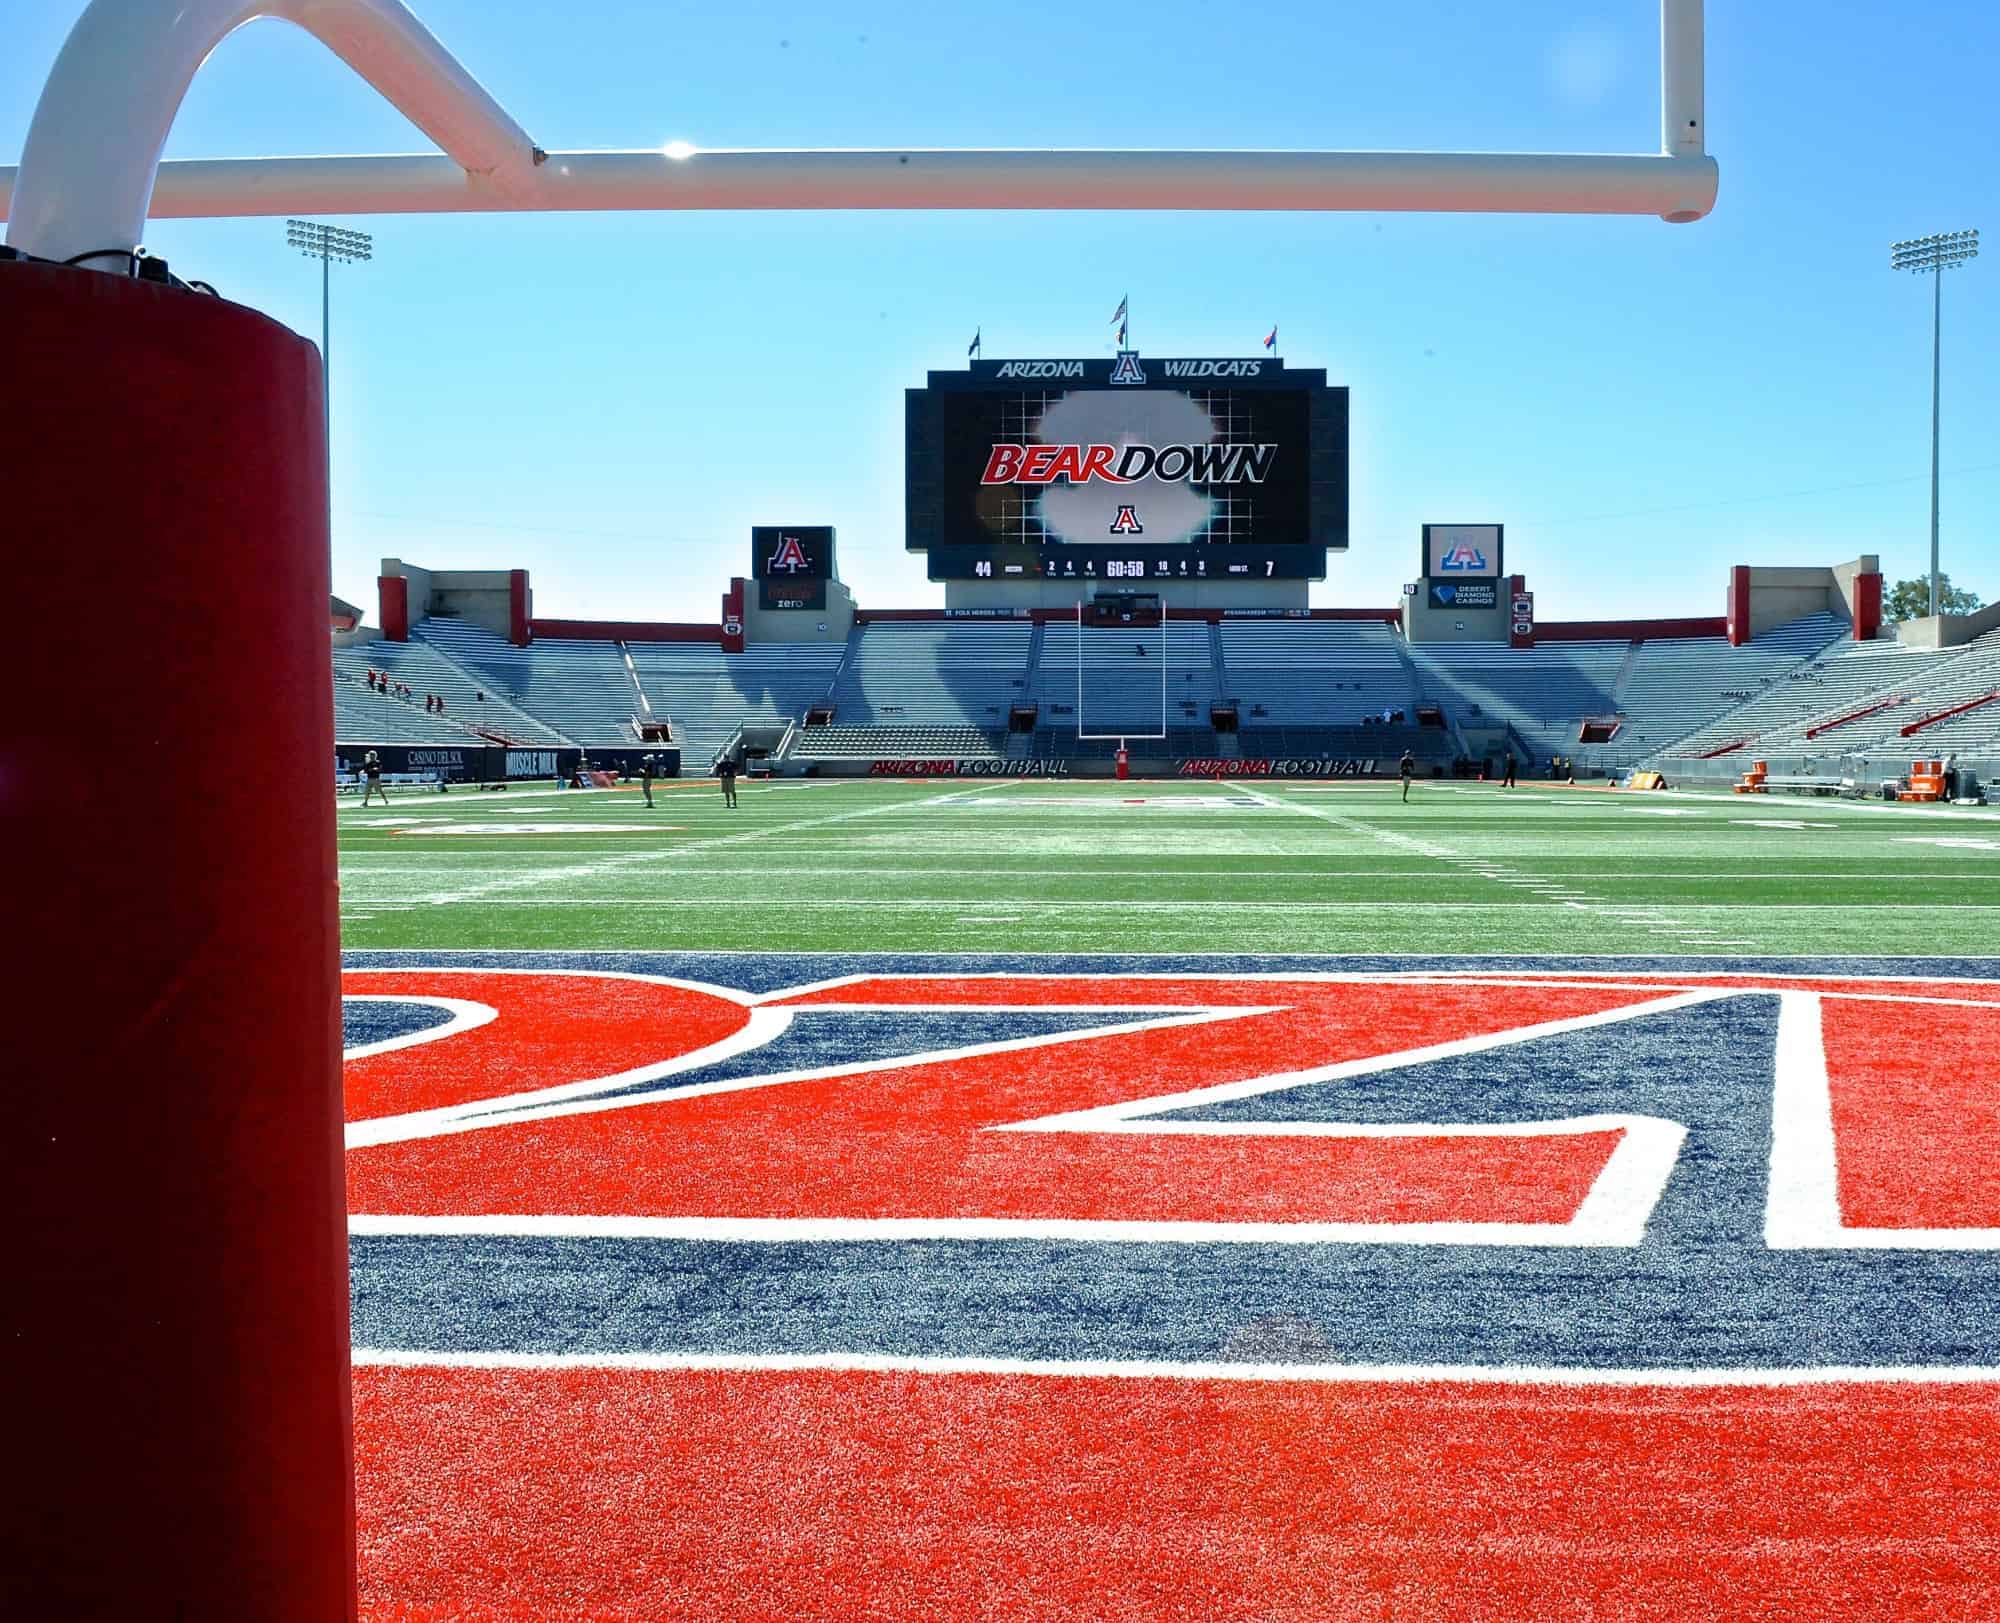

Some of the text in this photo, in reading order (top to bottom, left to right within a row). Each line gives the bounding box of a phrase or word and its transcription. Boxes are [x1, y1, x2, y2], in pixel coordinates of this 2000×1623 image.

[996, 361, 1084, 378] ARIZONA
[1164, 360, 1261, 377] WILDCATS
[1110, 505, 1143, 534] A
[975, 560, 992, 577] 44
[1048, 560, 1056, 571] 2
[1107, 560, 1144, 577] 60:58
[1265, 560, 1274, 577] 7
[777, 600, 804, 608] zero
[408, 751, 436, 765] CASINO
[506, 752, 558, 776] MUSCLE MILK
[871, 759, 1068, 775] ARIZONA FOOTBALL
[1180, 759, 1381, 775] ARIZONA FOOTBALL
